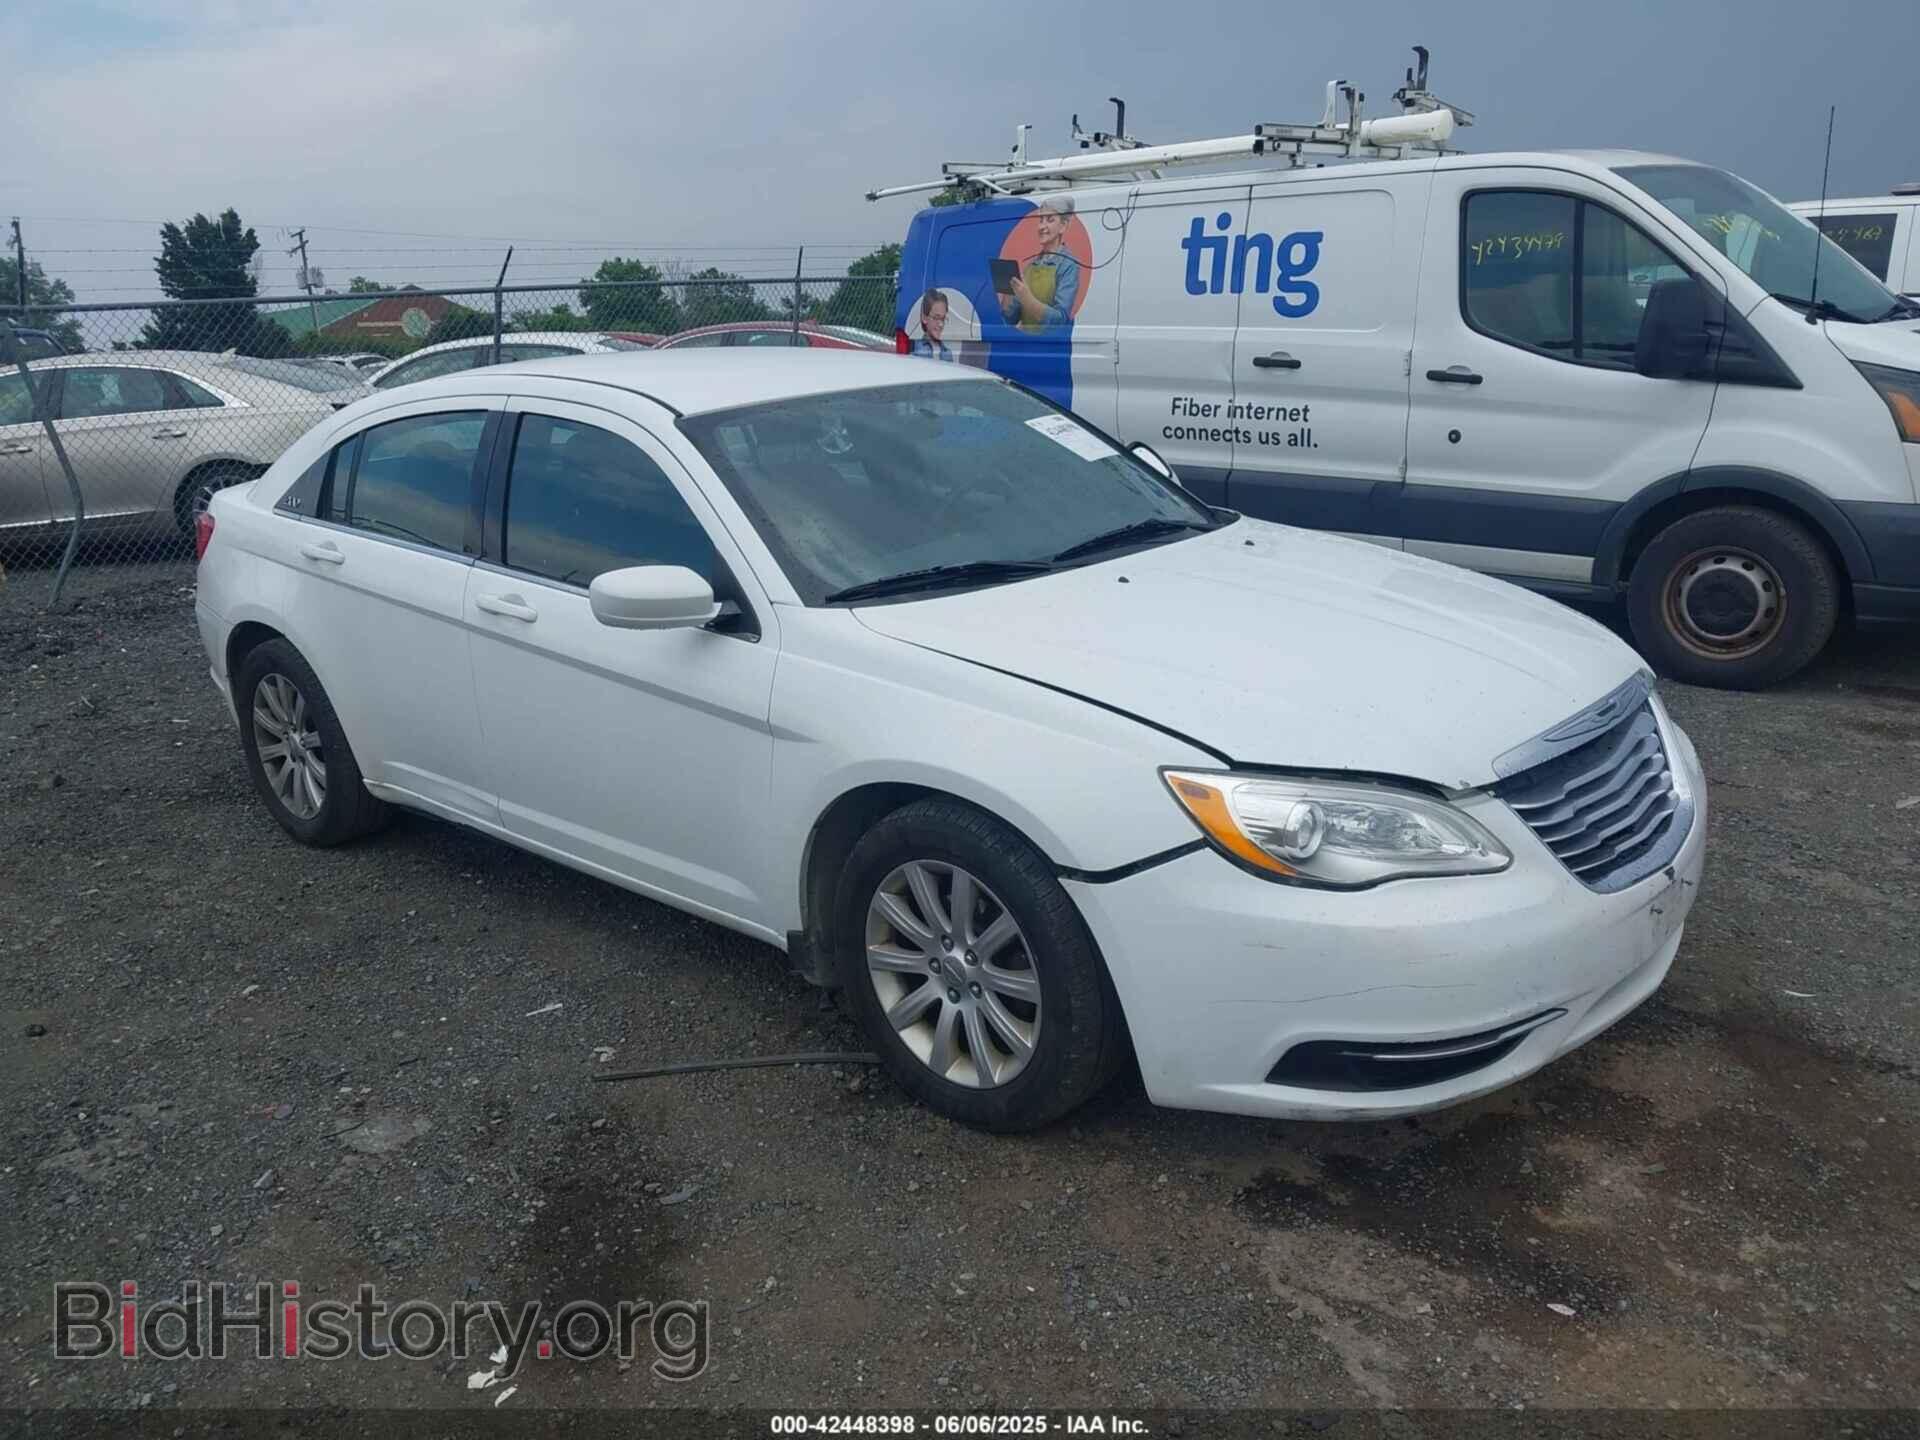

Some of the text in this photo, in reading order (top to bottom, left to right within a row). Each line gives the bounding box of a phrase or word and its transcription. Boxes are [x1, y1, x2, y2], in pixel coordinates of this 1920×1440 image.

[1181, 212, 1324, 318] ting
[1171, 397, 1310, 422] Fiber internet
[1162, 426, 1319, 449] connects us all.
